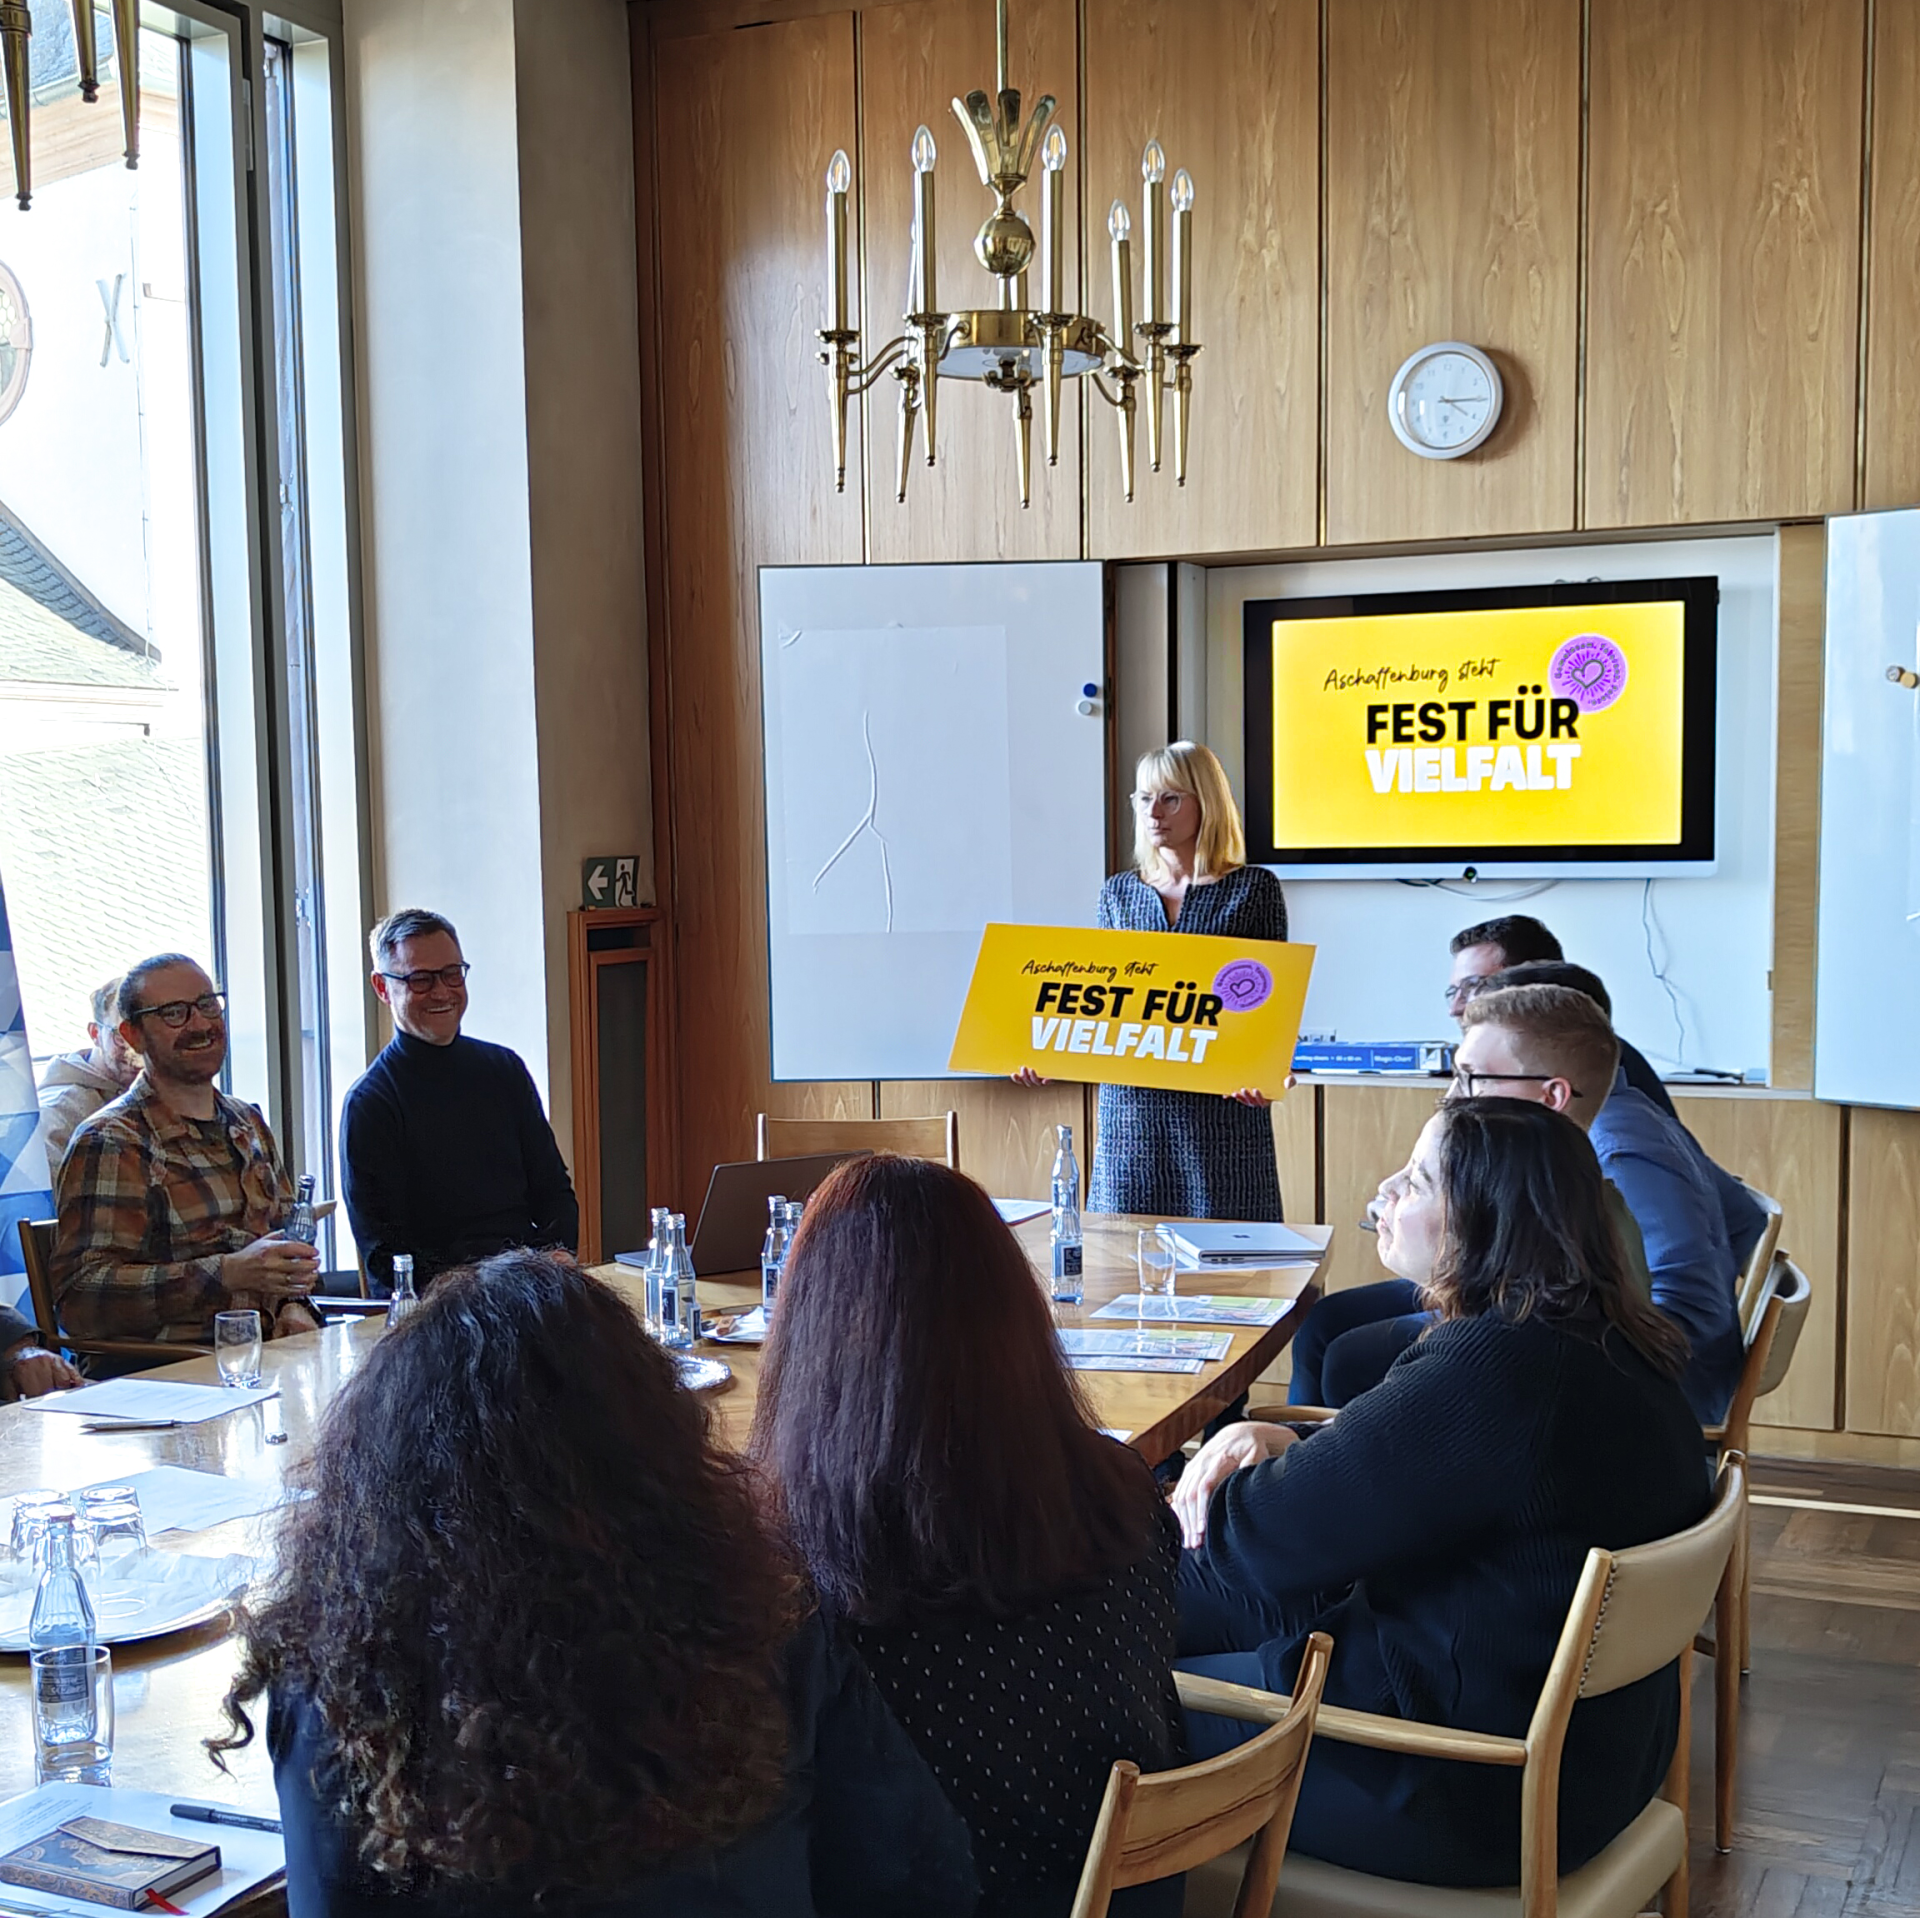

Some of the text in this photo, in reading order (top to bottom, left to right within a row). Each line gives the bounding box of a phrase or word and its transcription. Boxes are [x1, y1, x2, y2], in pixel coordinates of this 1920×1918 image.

[1323, 657, 1501, 694] Aschaffenburg steht
[1366, 701, 1477, 745] FEST
[1488, 684, 1580, 741] FÜR
[1365, 743, 1582, 794] VIELFALT
[1020, 958, 1160, 983] Aschaffenburg steht
[1035, 981, 1135, 1019] FEST
[1141, 980, 1224, 1027] FÜR
[1031, 1016, 1219, 1064] VIELFALT
